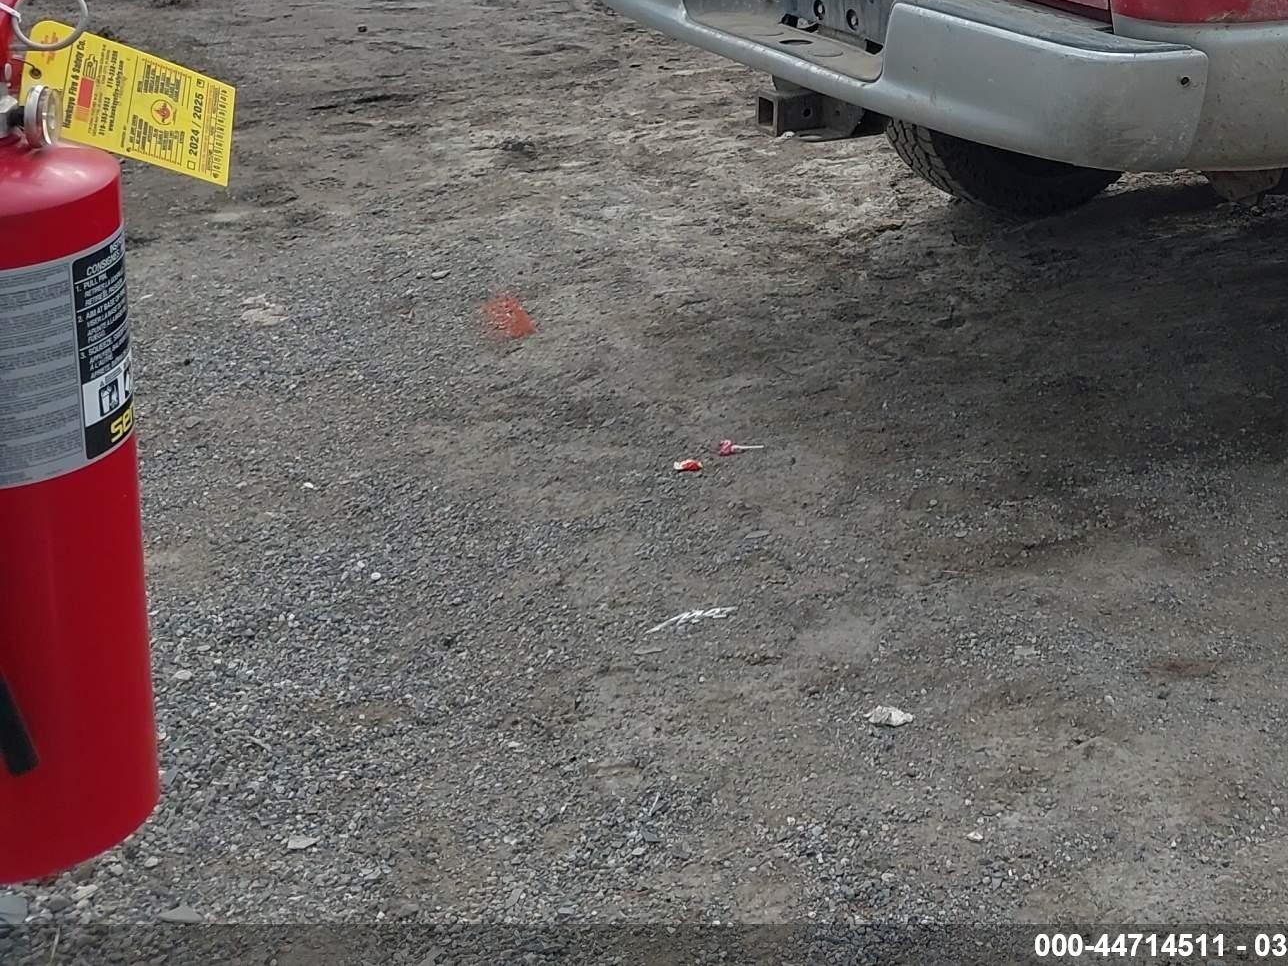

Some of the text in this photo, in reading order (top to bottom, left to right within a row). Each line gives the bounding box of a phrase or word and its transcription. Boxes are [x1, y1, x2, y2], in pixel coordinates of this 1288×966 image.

[72, 52, 85, 74] Safety
[193, 92, 204, 117] 2025
[189, 129, 199, 156] 2024
